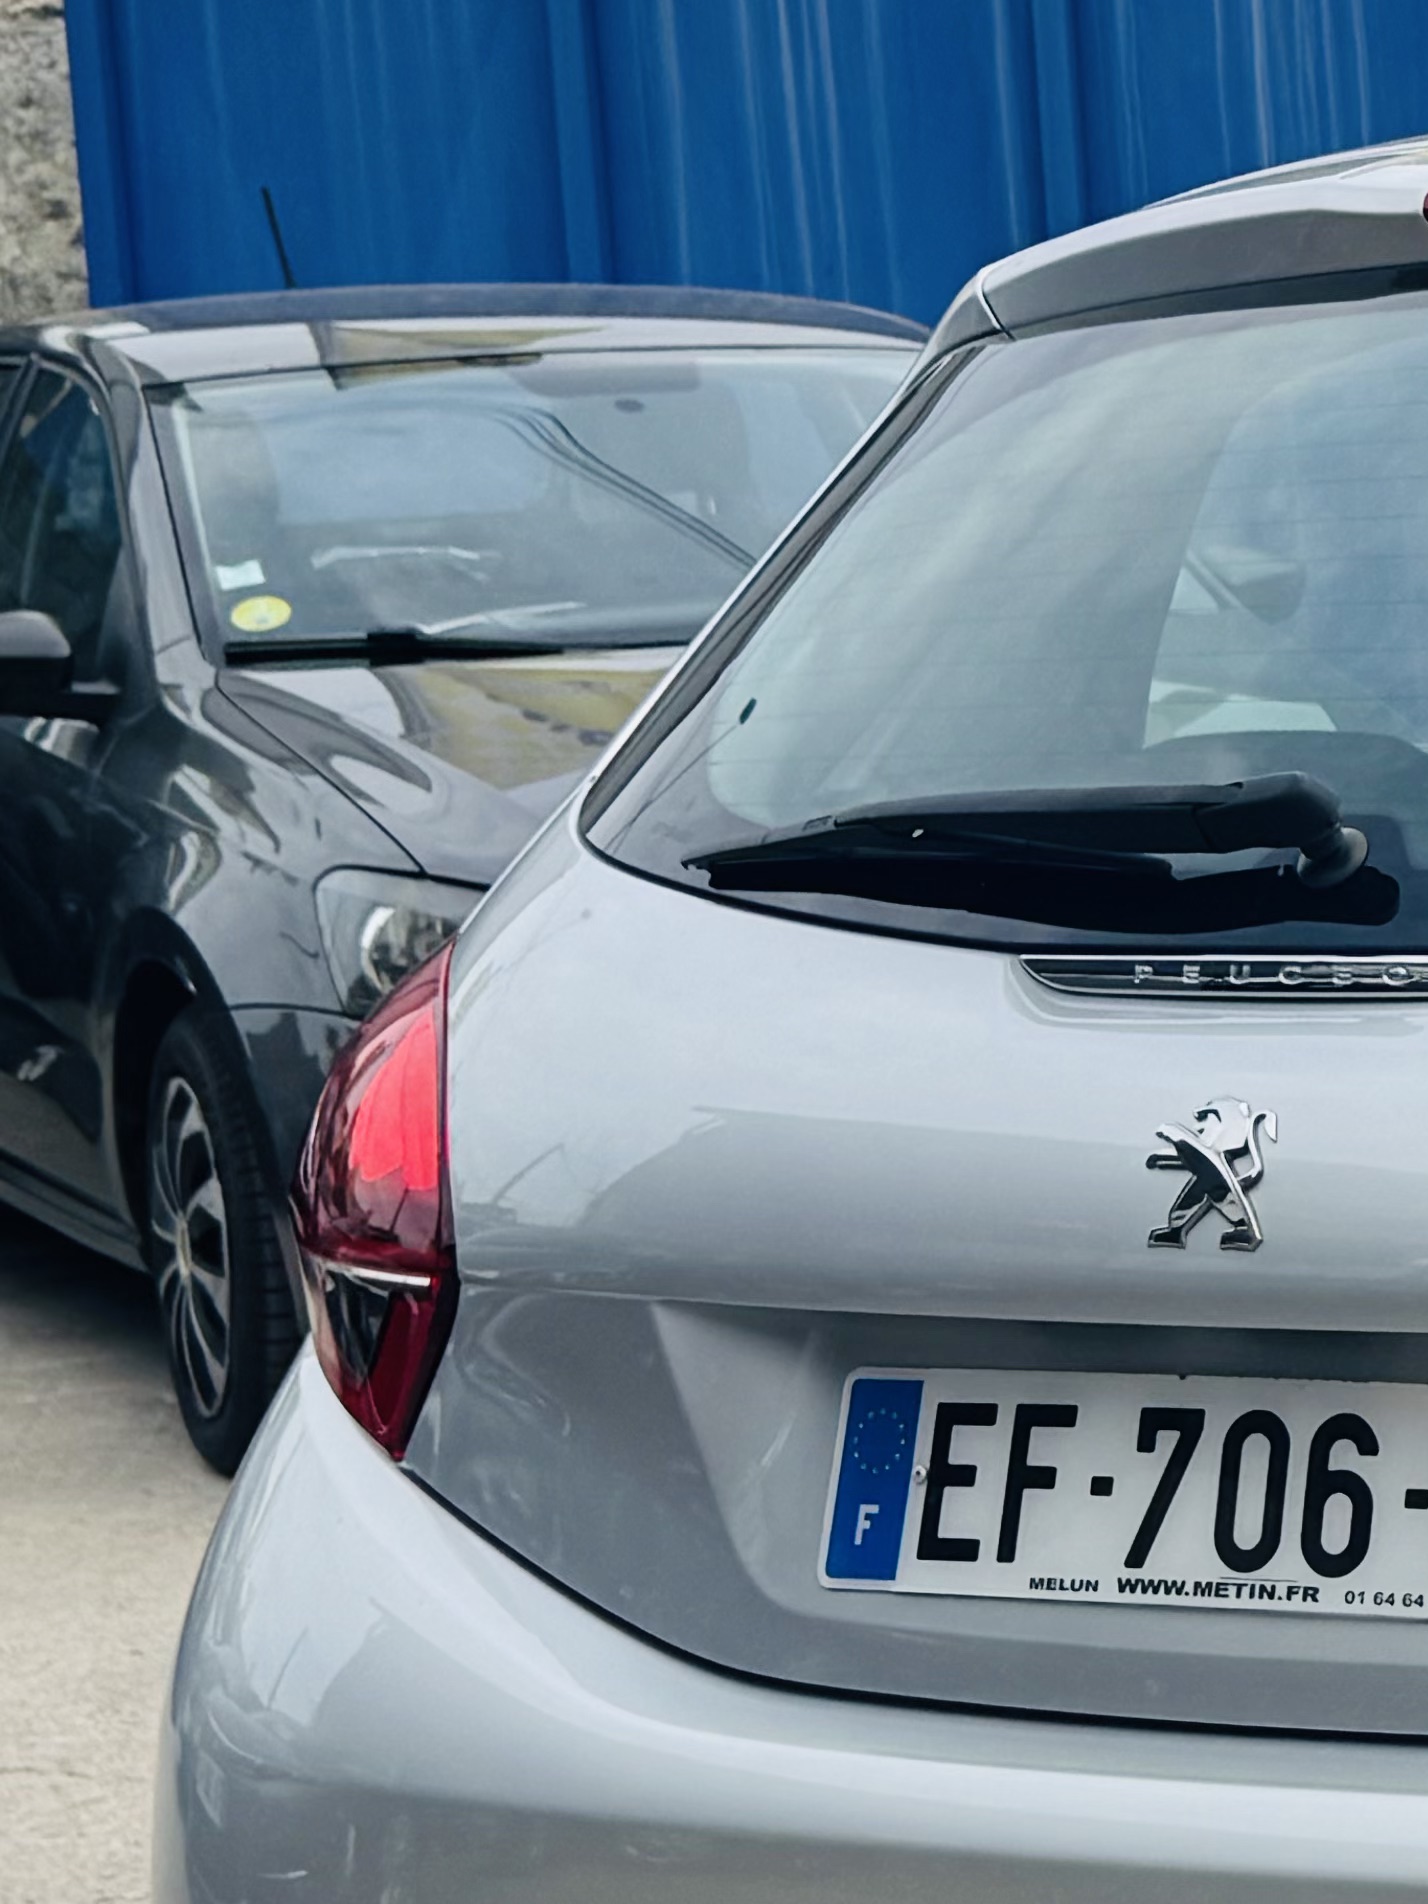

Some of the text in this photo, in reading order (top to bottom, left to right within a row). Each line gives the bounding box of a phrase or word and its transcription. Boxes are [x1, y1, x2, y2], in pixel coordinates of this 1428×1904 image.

[853, 1503, 881, 1546] F
[1028, 1576, 1100, 1593] MELUN
[1116, 1577, 1321, 1603] WWW.METIN.FR
[1344, 1590, 1366, 1606] 01
[1373, 1591, 1396, 1607] 64
[1402, 1592, 1425, 1608] 64
